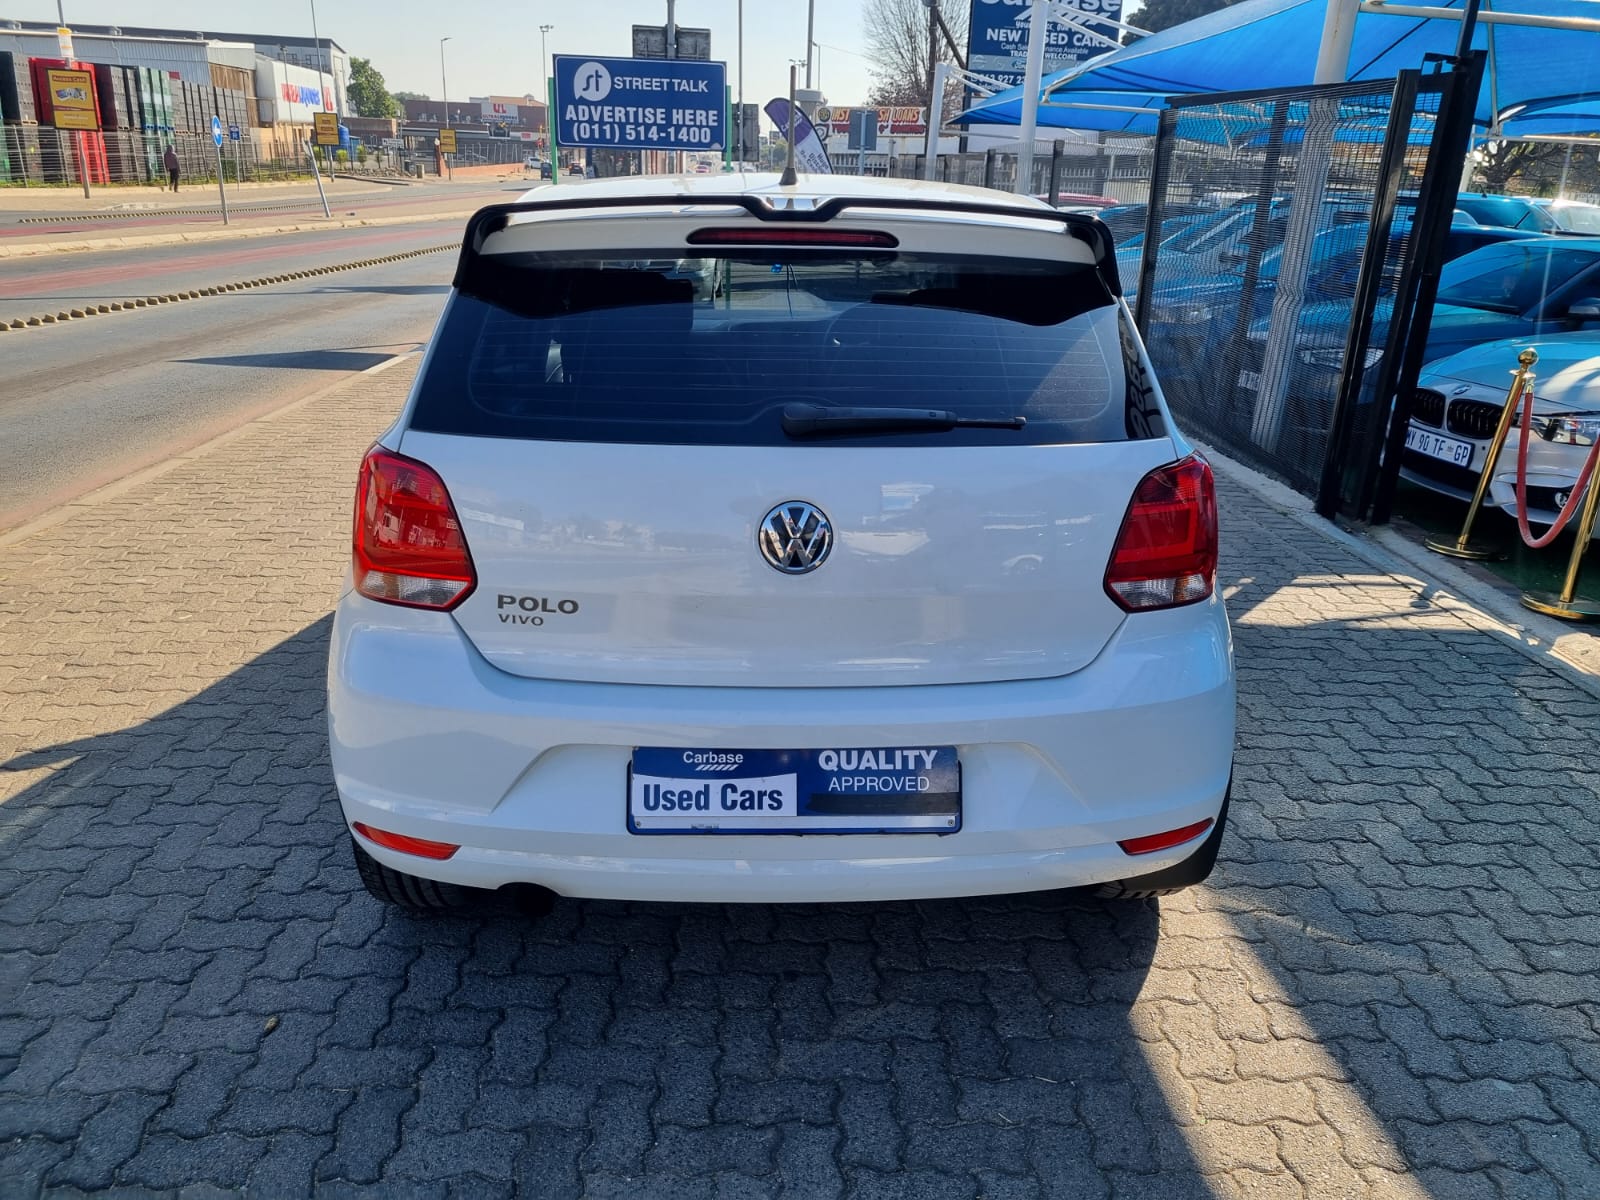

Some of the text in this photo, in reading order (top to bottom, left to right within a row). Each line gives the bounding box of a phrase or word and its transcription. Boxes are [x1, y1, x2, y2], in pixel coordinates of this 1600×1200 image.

[986, 28, 1022, 42] NEW
[1044, 31, 1068, 46] SED
[1010, 50, 1078, 61] TRAD WELCOME
[613, 76, 670, 91] STREET
[671, 79, 709, 93] TALK
[565, 105, 719, 127] ADVERTISE HERE
[573, 122, 712, 143] (011) 514-1400
[1419, 433, 1430, 451] 90
[1433, 438, 1446, 456] TF
[1454, 444, 1469, 463] GP
[497, 594, 579, 614] POLO
[498, 613, 544, 626] VIVO
[682, 751, 744, 764] Carbase
[818, 750, 938, 771] QUALITY
[828, 776, 930, 792] APPROVED
[643, 783, 783, 812] Used Cars
